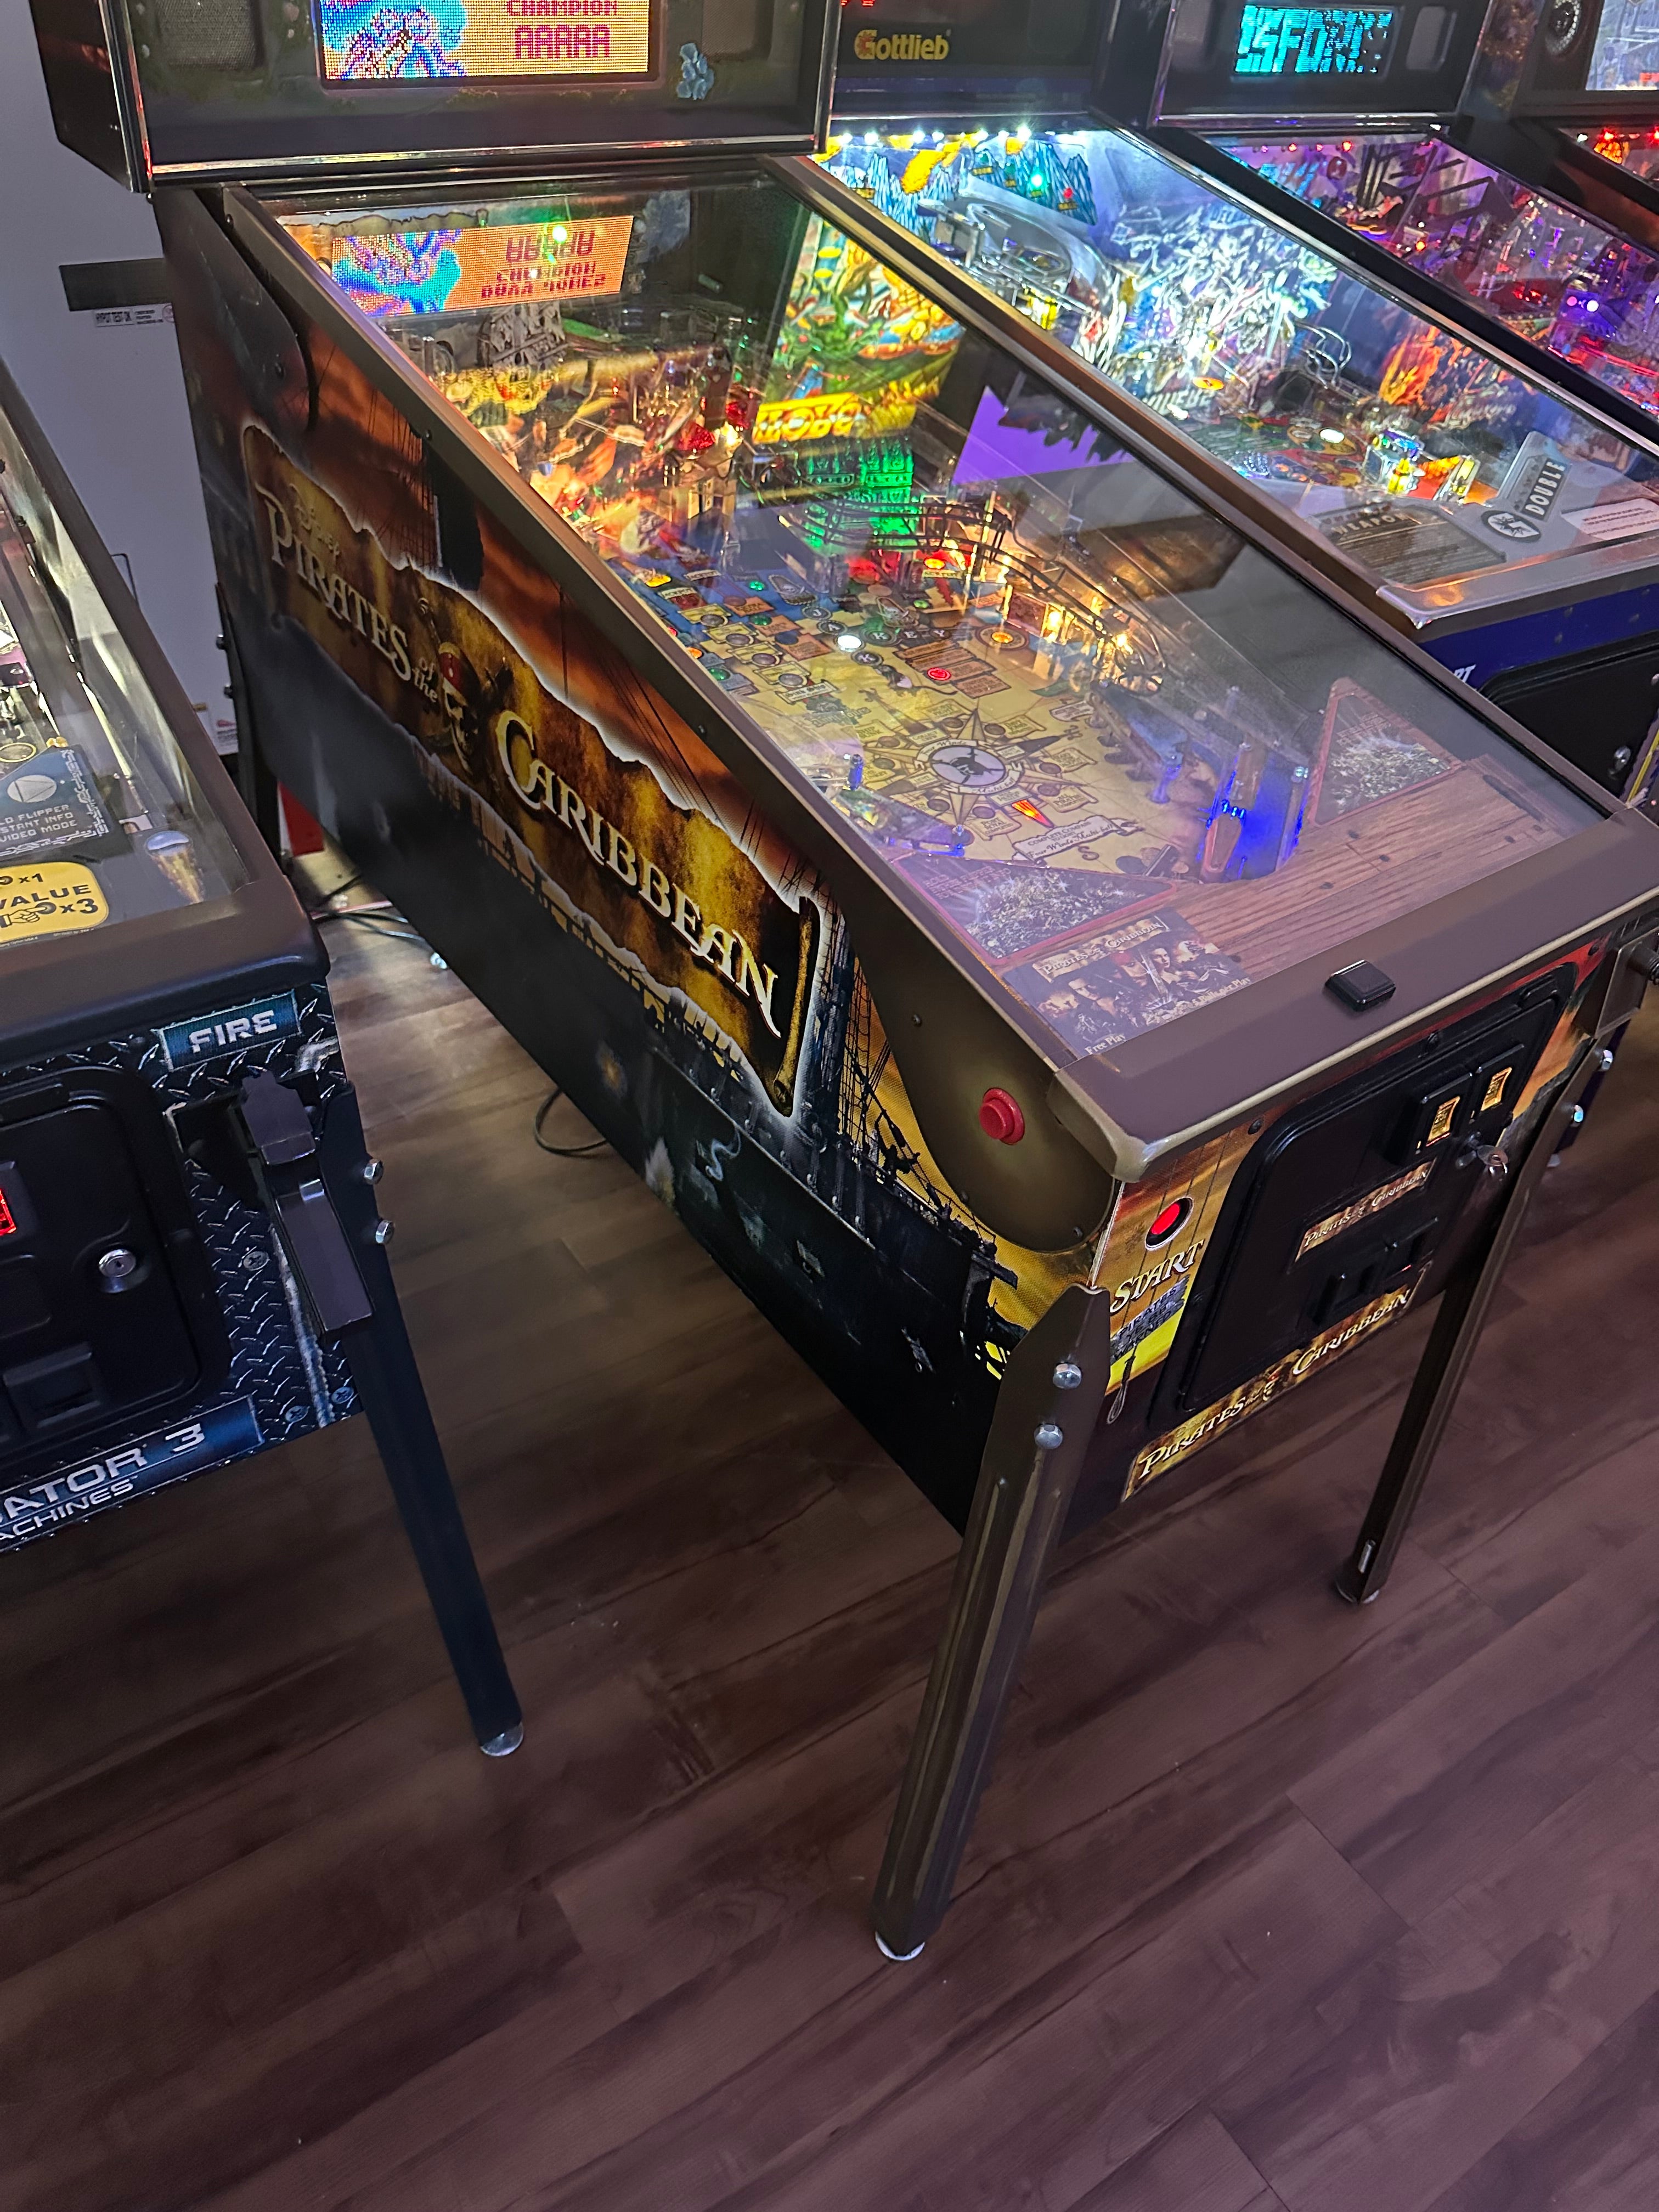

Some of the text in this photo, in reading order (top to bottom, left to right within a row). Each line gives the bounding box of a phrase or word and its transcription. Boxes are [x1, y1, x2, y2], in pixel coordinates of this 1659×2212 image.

[515, 25, 610, 59] AAAAA
[854, 30, 949, 60] Gottlieb
[1525, 461, 1565, 516] DOUBLE
[255, 482, 411, 681] PIRATES
[828, 624, 842, 632] A
[419, 656, 436, 680] of
[857, 653, 876, 663] K
[1454, 664, 1476, 684] RT
[413, 667, 438, 704] the
[18, 804, 70, 821] FLIPPER
[41, 820, 77, 833] MODE
[46, 812, 74, 823] INFO
[1028, 831, 1062, 846] COMPLETE
[495, 709, 781, 1038] CARIBBEAN
[59, 898, 99, 914] x3
[1040, 951, 1088, 975] PIRATES
[1105, 922, 1164, 949] CARIBBEAN
[189, 1009, 278, 1054] FIRE
[1085, 1033, 1126, 1056] Free Play
[1304, 1212, 1352, 1248] PIRATES
[1110, 1239, 1205, 1313] START
[1118, 1285, 1177, 1340] PIRATES
[1138, 1288, 1411, 1480] PIRATES CARIBBEAN
[0, 1423, 205, 1524] ATOR 3
